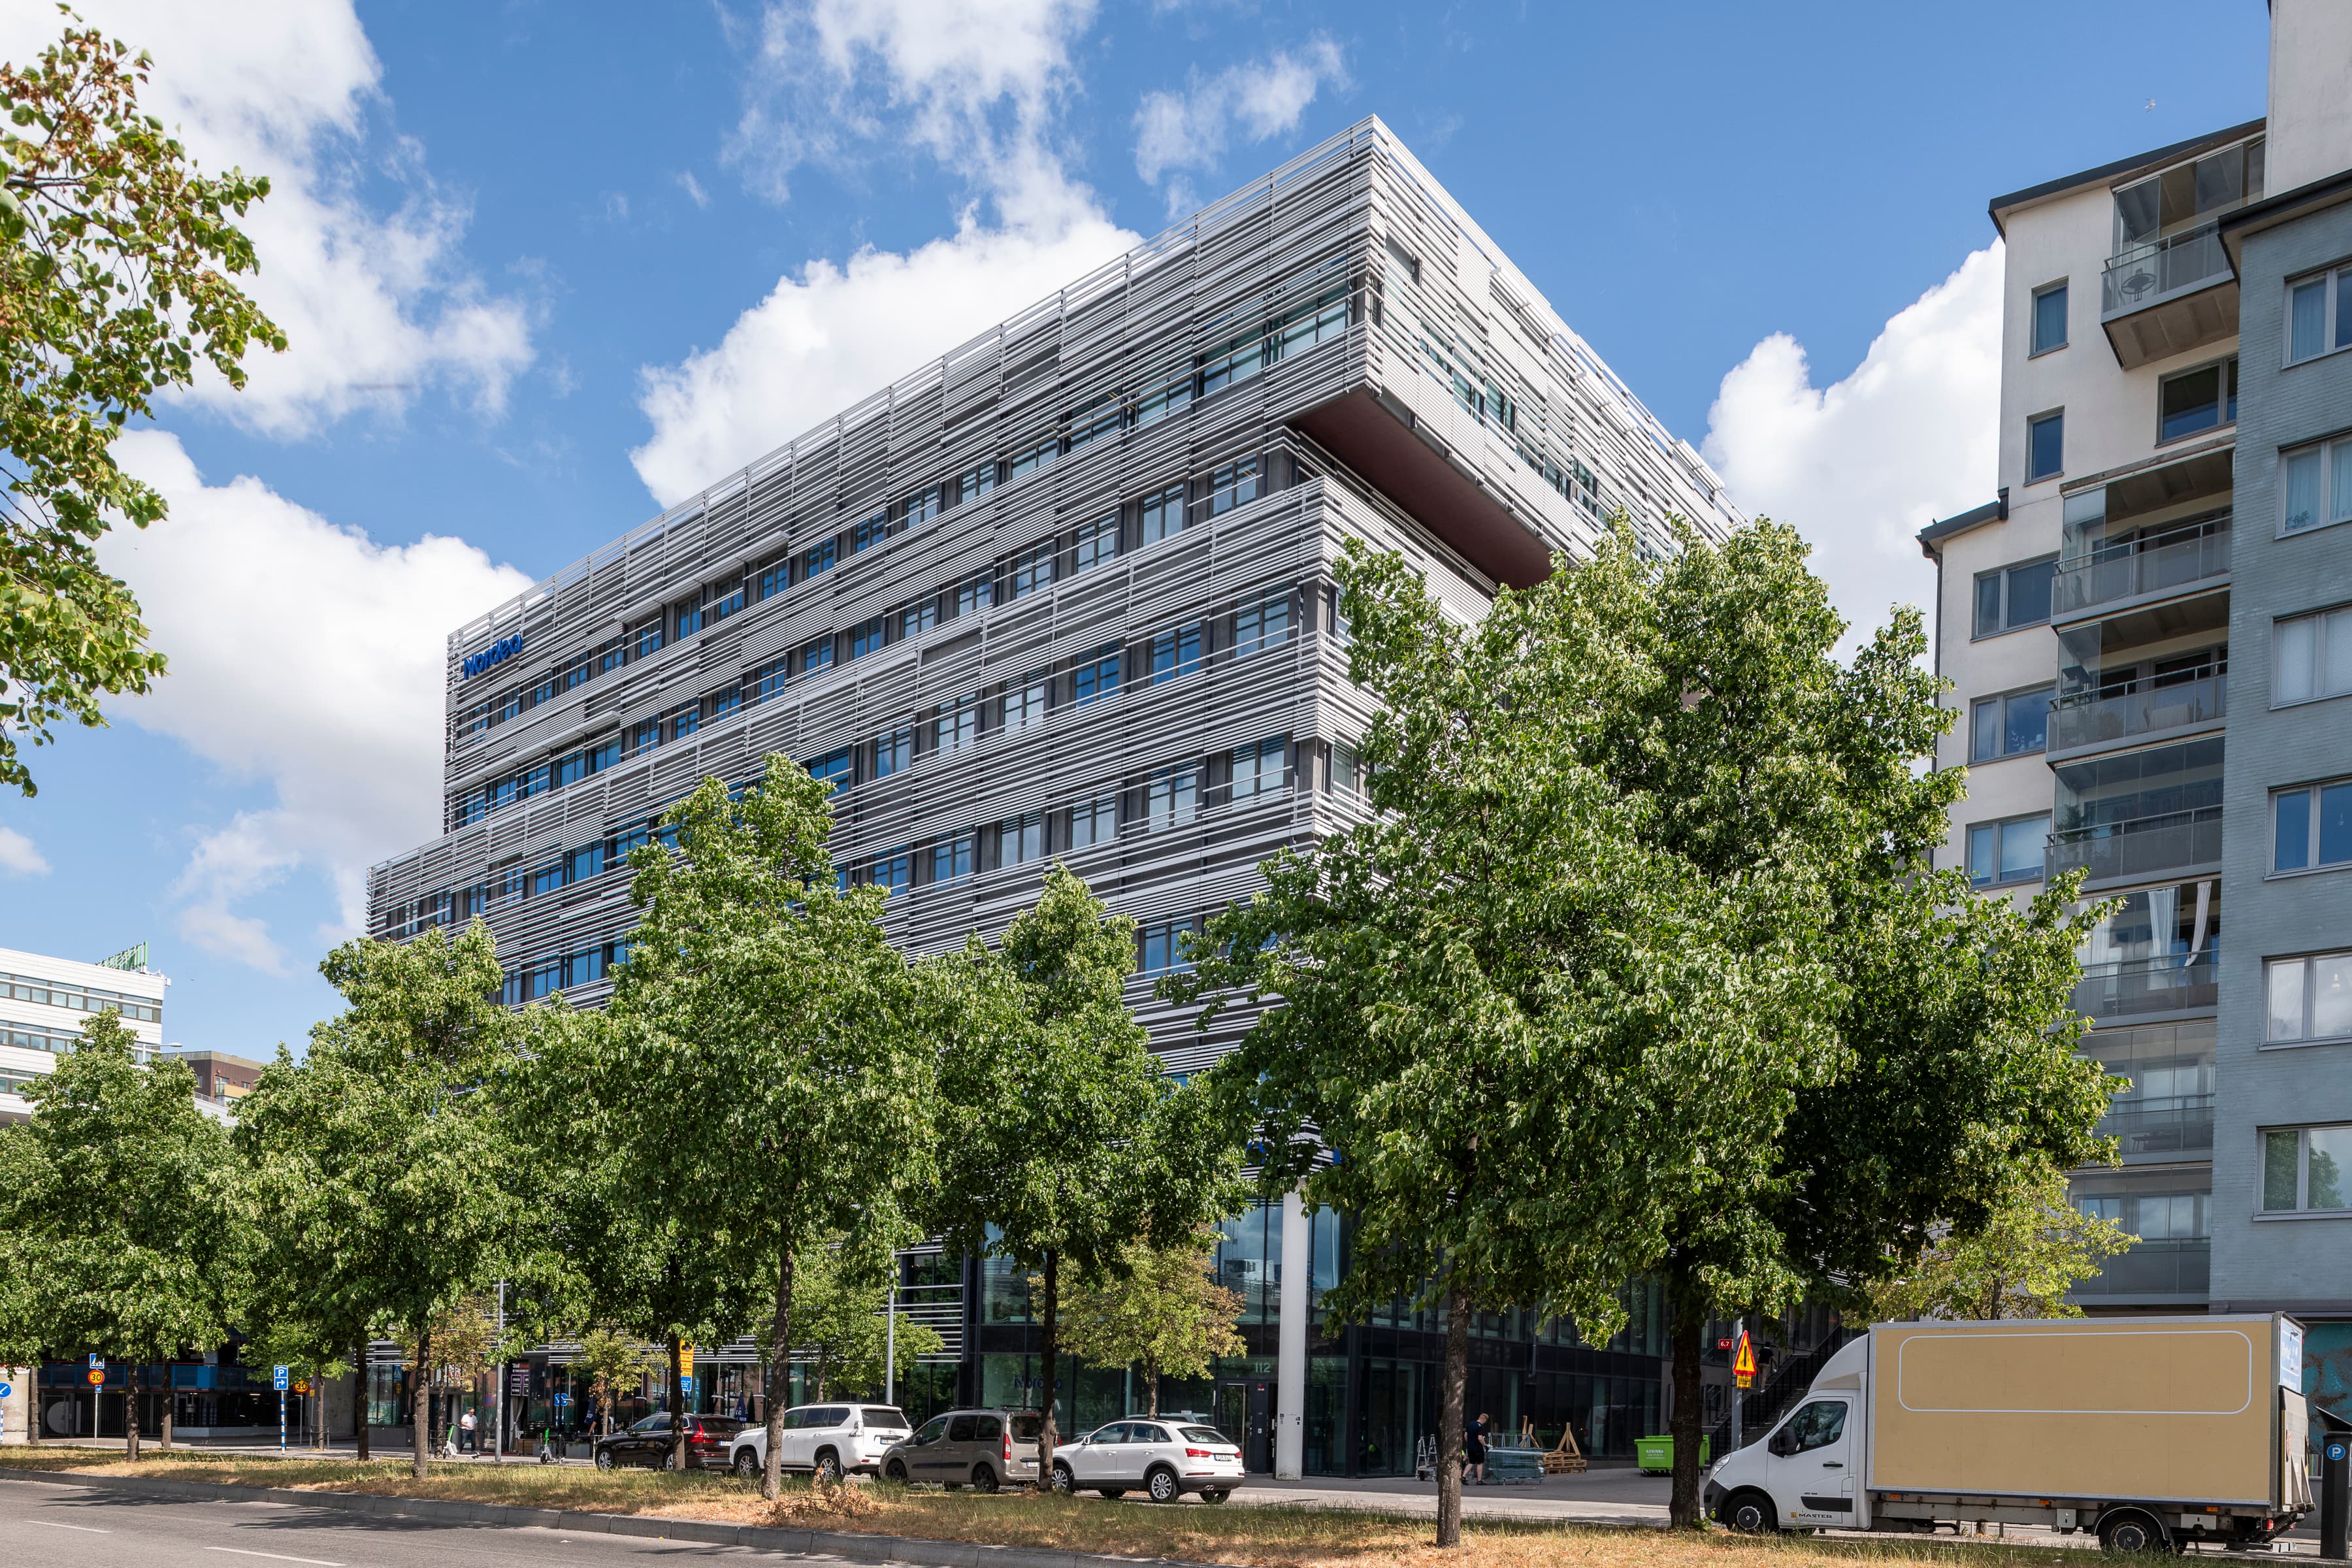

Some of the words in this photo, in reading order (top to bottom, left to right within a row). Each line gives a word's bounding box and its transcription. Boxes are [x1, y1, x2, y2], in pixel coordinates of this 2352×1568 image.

[464, 634, 523, 679] Nordea
[1255, 1362, 1271, 1373] 112
[2332, 1447, 2342, 1458] P
